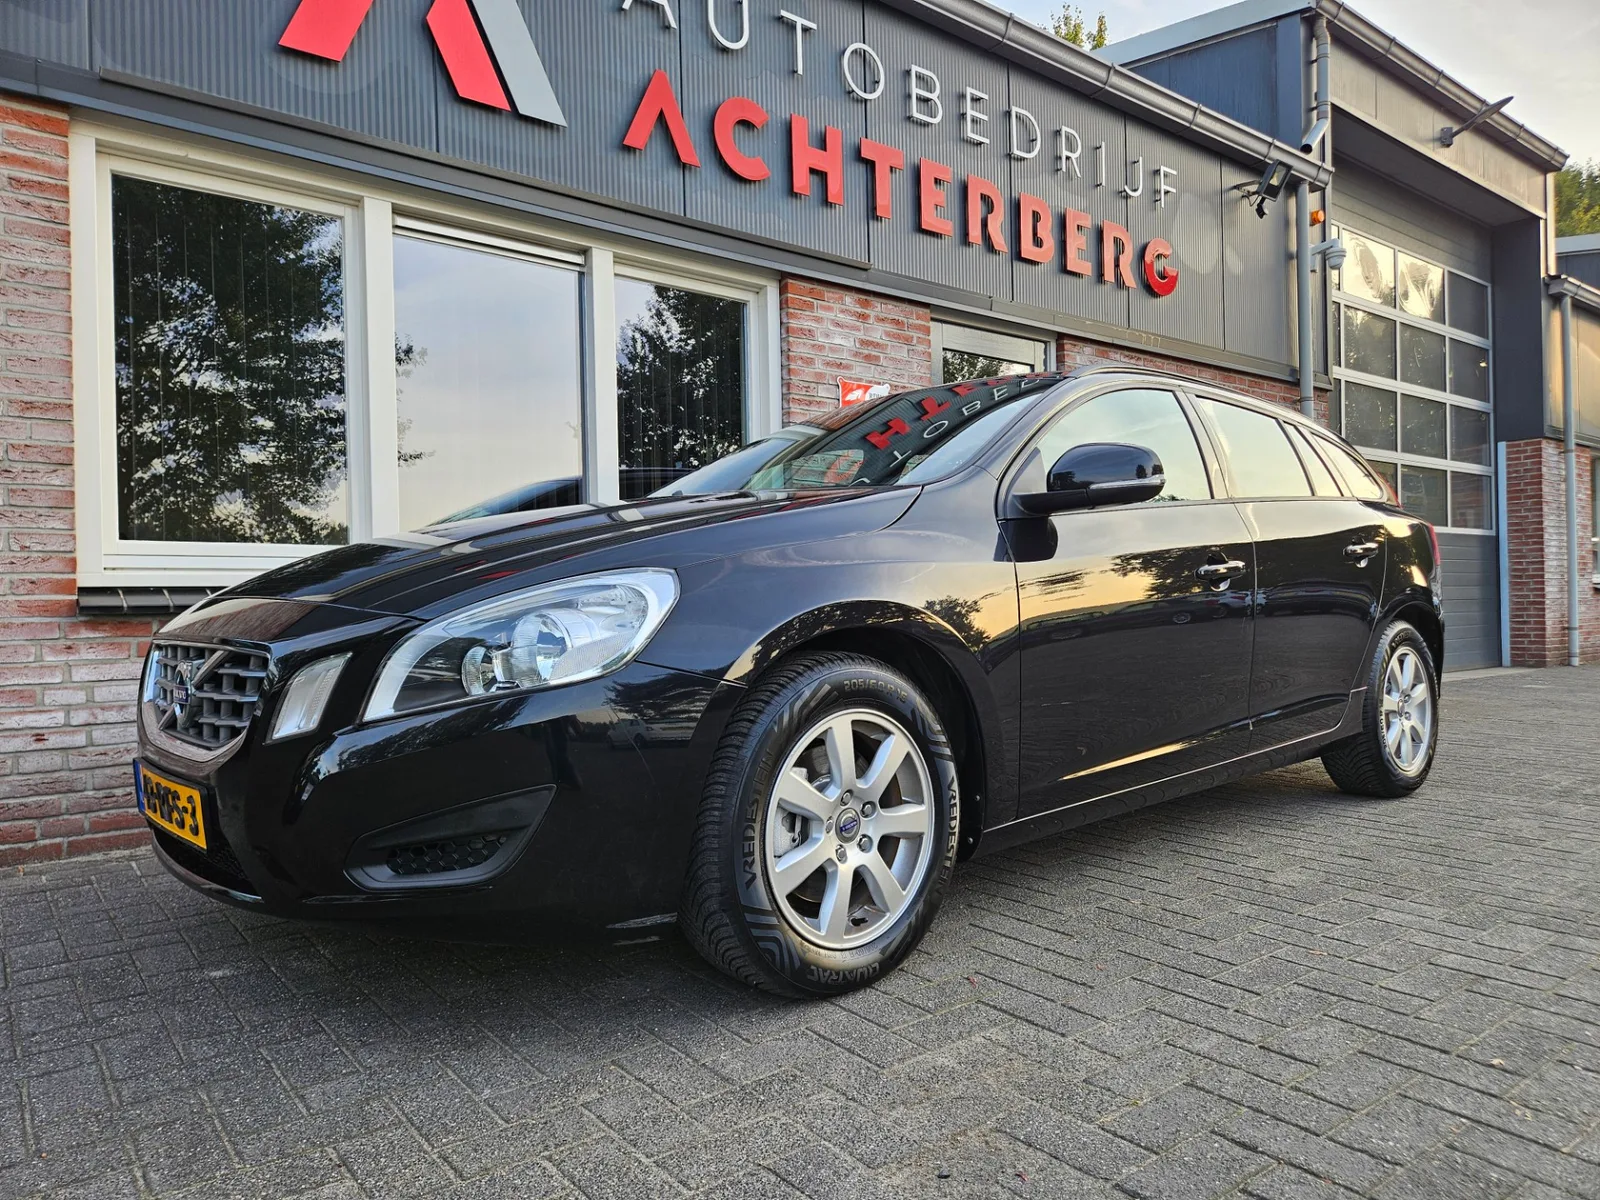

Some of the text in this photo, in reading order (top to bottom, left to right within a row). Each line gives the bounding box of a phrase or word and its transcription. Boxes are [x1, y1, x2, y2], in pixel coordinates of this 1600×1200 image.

[622, 0, 1177, 207] UTOBEDRIJF
[623, 69, 1179, 297] ACHTERBERG
[742, 748, 774, 891] VREDESTEIN
